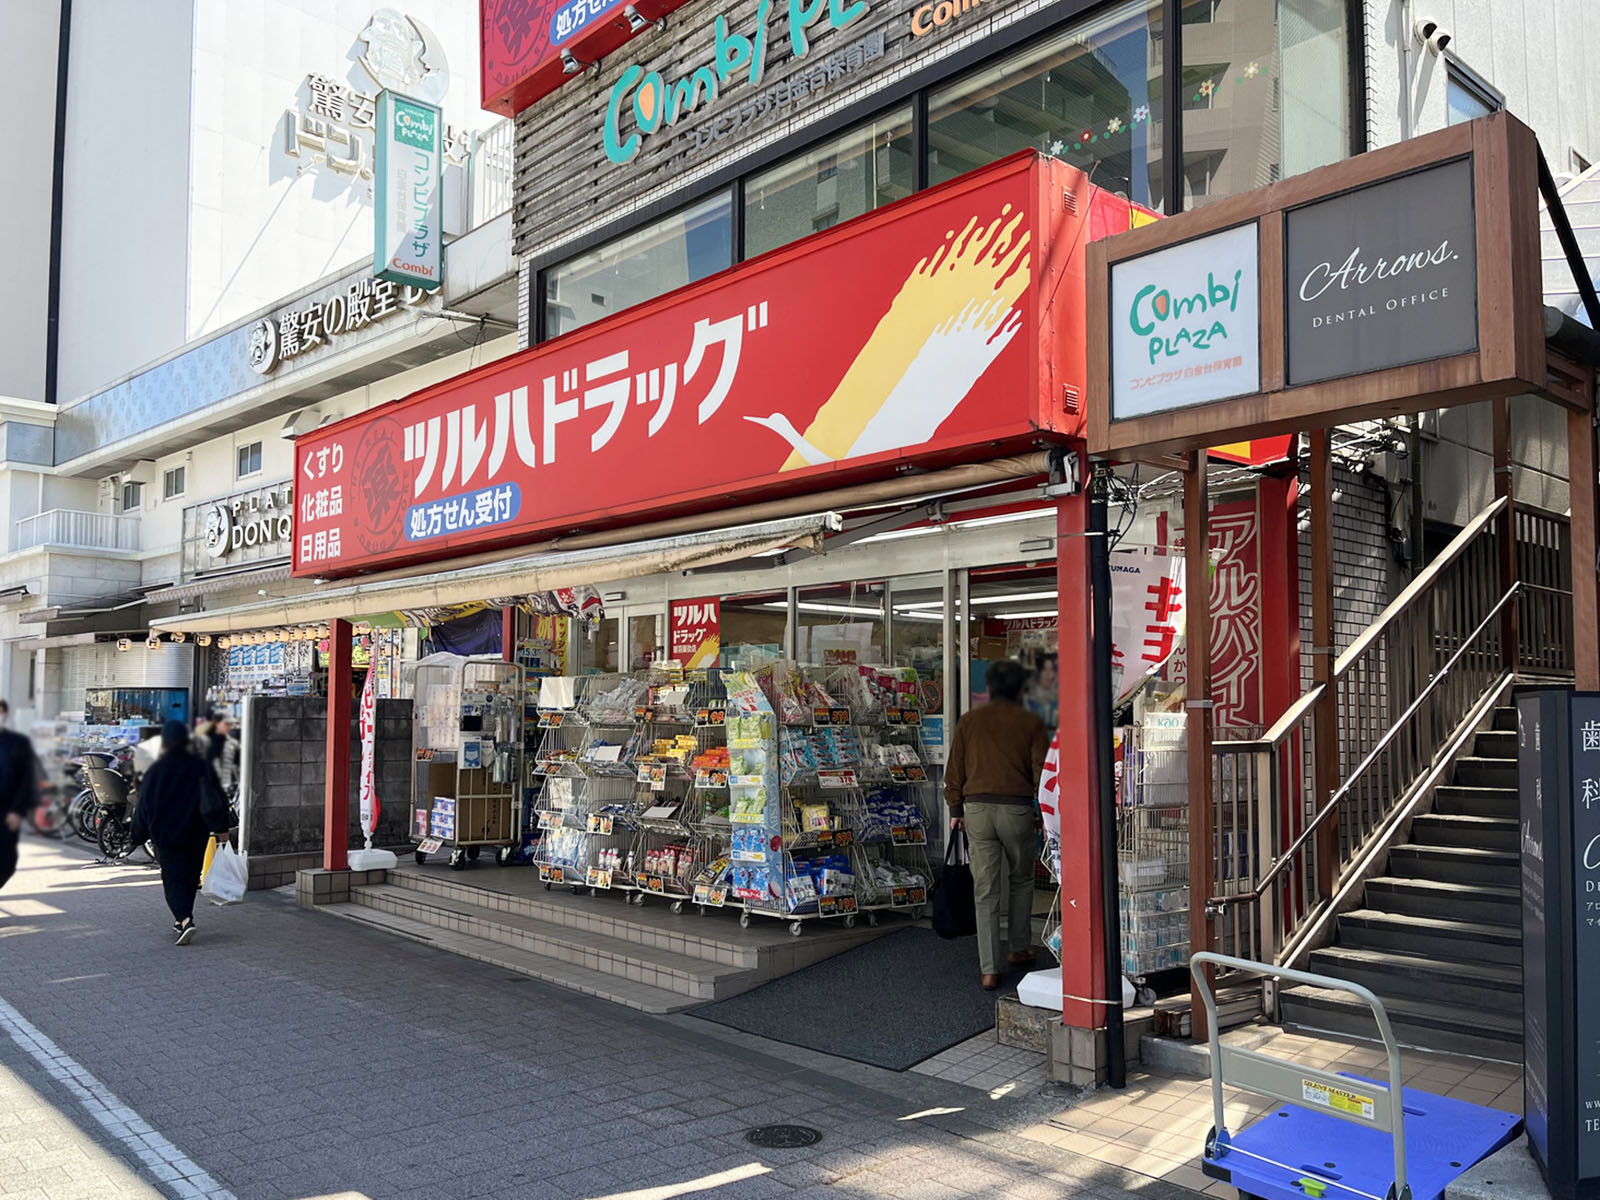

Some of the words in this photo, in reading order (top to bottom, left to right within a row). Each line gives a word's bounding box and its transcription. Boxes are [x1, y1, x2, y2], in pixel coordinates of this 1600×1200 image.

[556, 0, 614, 40] 処方せ
[686, 31, 886, 155] コンビプラザ白金台保育園
[412, 151, 431, 258] コンビプラザ
[392, 257, 433, 277] Combi
[1129, 269, 1242, 336] Combi
[1312, 305, 1377, 328] DENTAL
[1385, 287, 1450, 312] OFFICE
[1149, 320, 1228, 365] PLAZA
[403, 300, 769, 499] ツルハドラッグ
[303, 443, 344, 481] くすり
[301, 485, 343, 524] 化粧品
[409, 489, 513, 541] 処方せん受付
[232, 519, 273, 550] DON
[301, 527, 342, 564] 日用品
[673, 603, 717, 627] ツルハ
[673, 628, 707, 644] ドラッグ
